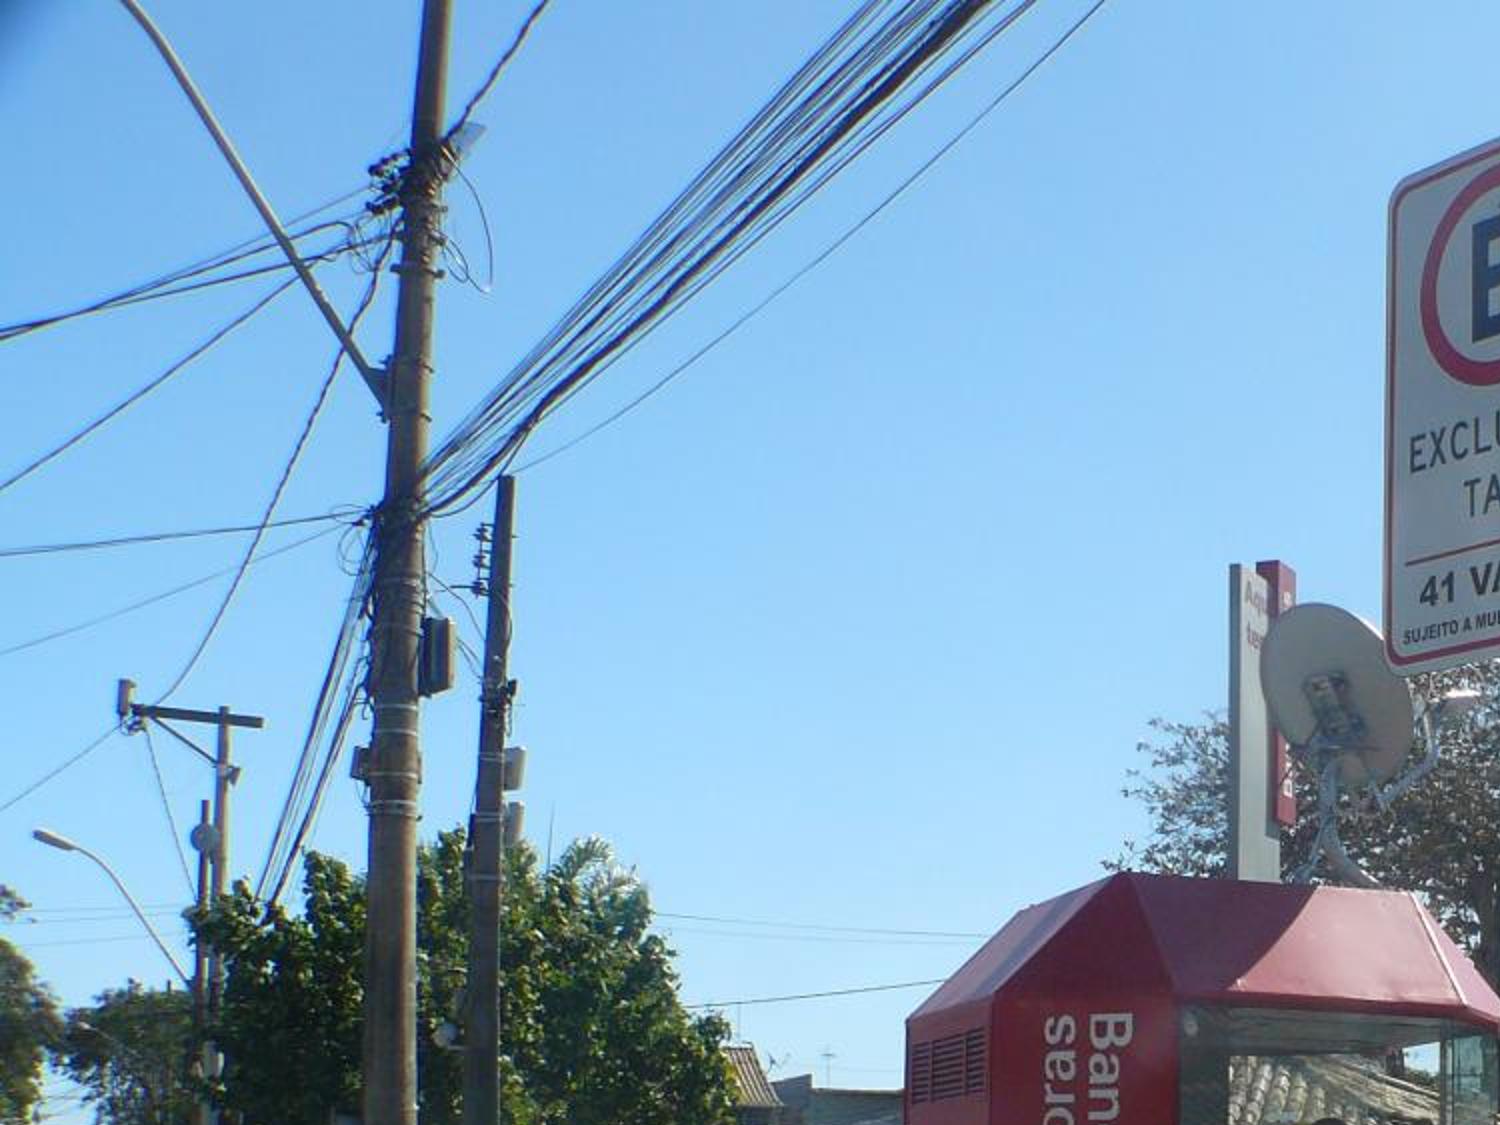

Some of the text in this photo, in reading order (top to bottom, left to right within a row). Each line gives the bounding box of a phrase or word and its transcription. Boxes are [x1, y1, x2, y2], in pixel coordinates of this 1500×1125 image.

[1419, 570, 1455, 607] 41
[1403, 619, 1459, 645] SUJEITO
[1462, 617, 1473, 632] A
